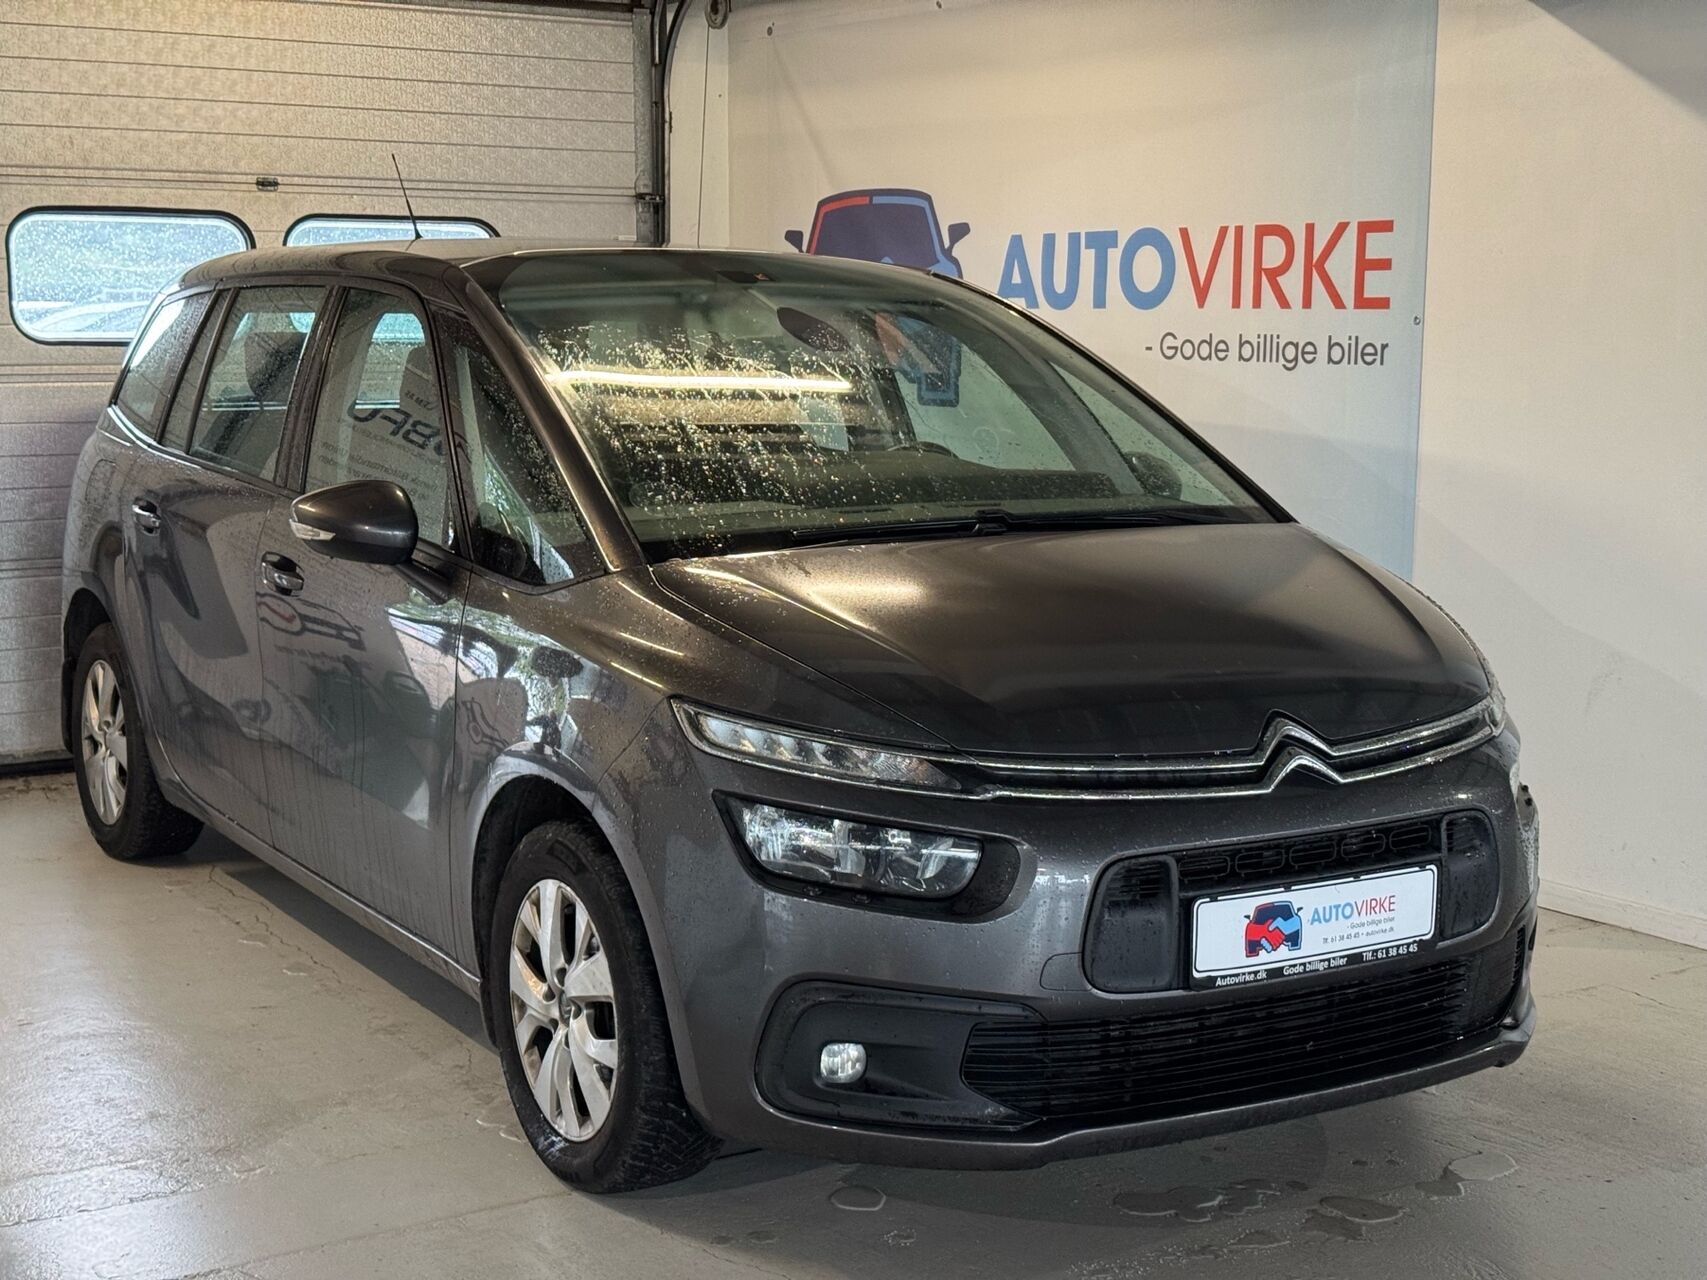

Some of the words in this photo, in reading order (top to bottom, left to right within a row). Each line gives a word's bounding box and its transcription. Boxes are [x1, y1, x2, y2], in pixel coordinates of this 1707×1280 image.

[996, 219, 1395, 311] AUTOVIRKE
[1159, 331, 1230, 362] Gode
[1238, 333, 1318, 371] billige
[1327, 335, 1389, 366] biler
[1310, 895, 1396, 925] AUTOVIRKE
[1350, 921, 1366, 930] Gode
[1366, 918, 1382, 928] billige
[1383, 916, 1395, 924] biler
[1215, 970, 1267, 987] Autovirke.dk
[1283, 964, 1305, 976] Gode
[1306, 960, 1329, 971] billige
[1330, 957, 1348, 968] biler
[1377, 949, 1387, 959] 61
[1388, 947, 1397, 957] 38
[1398, 945, 1408, 955] 45
[1409, 943, 1418, 953] 45
